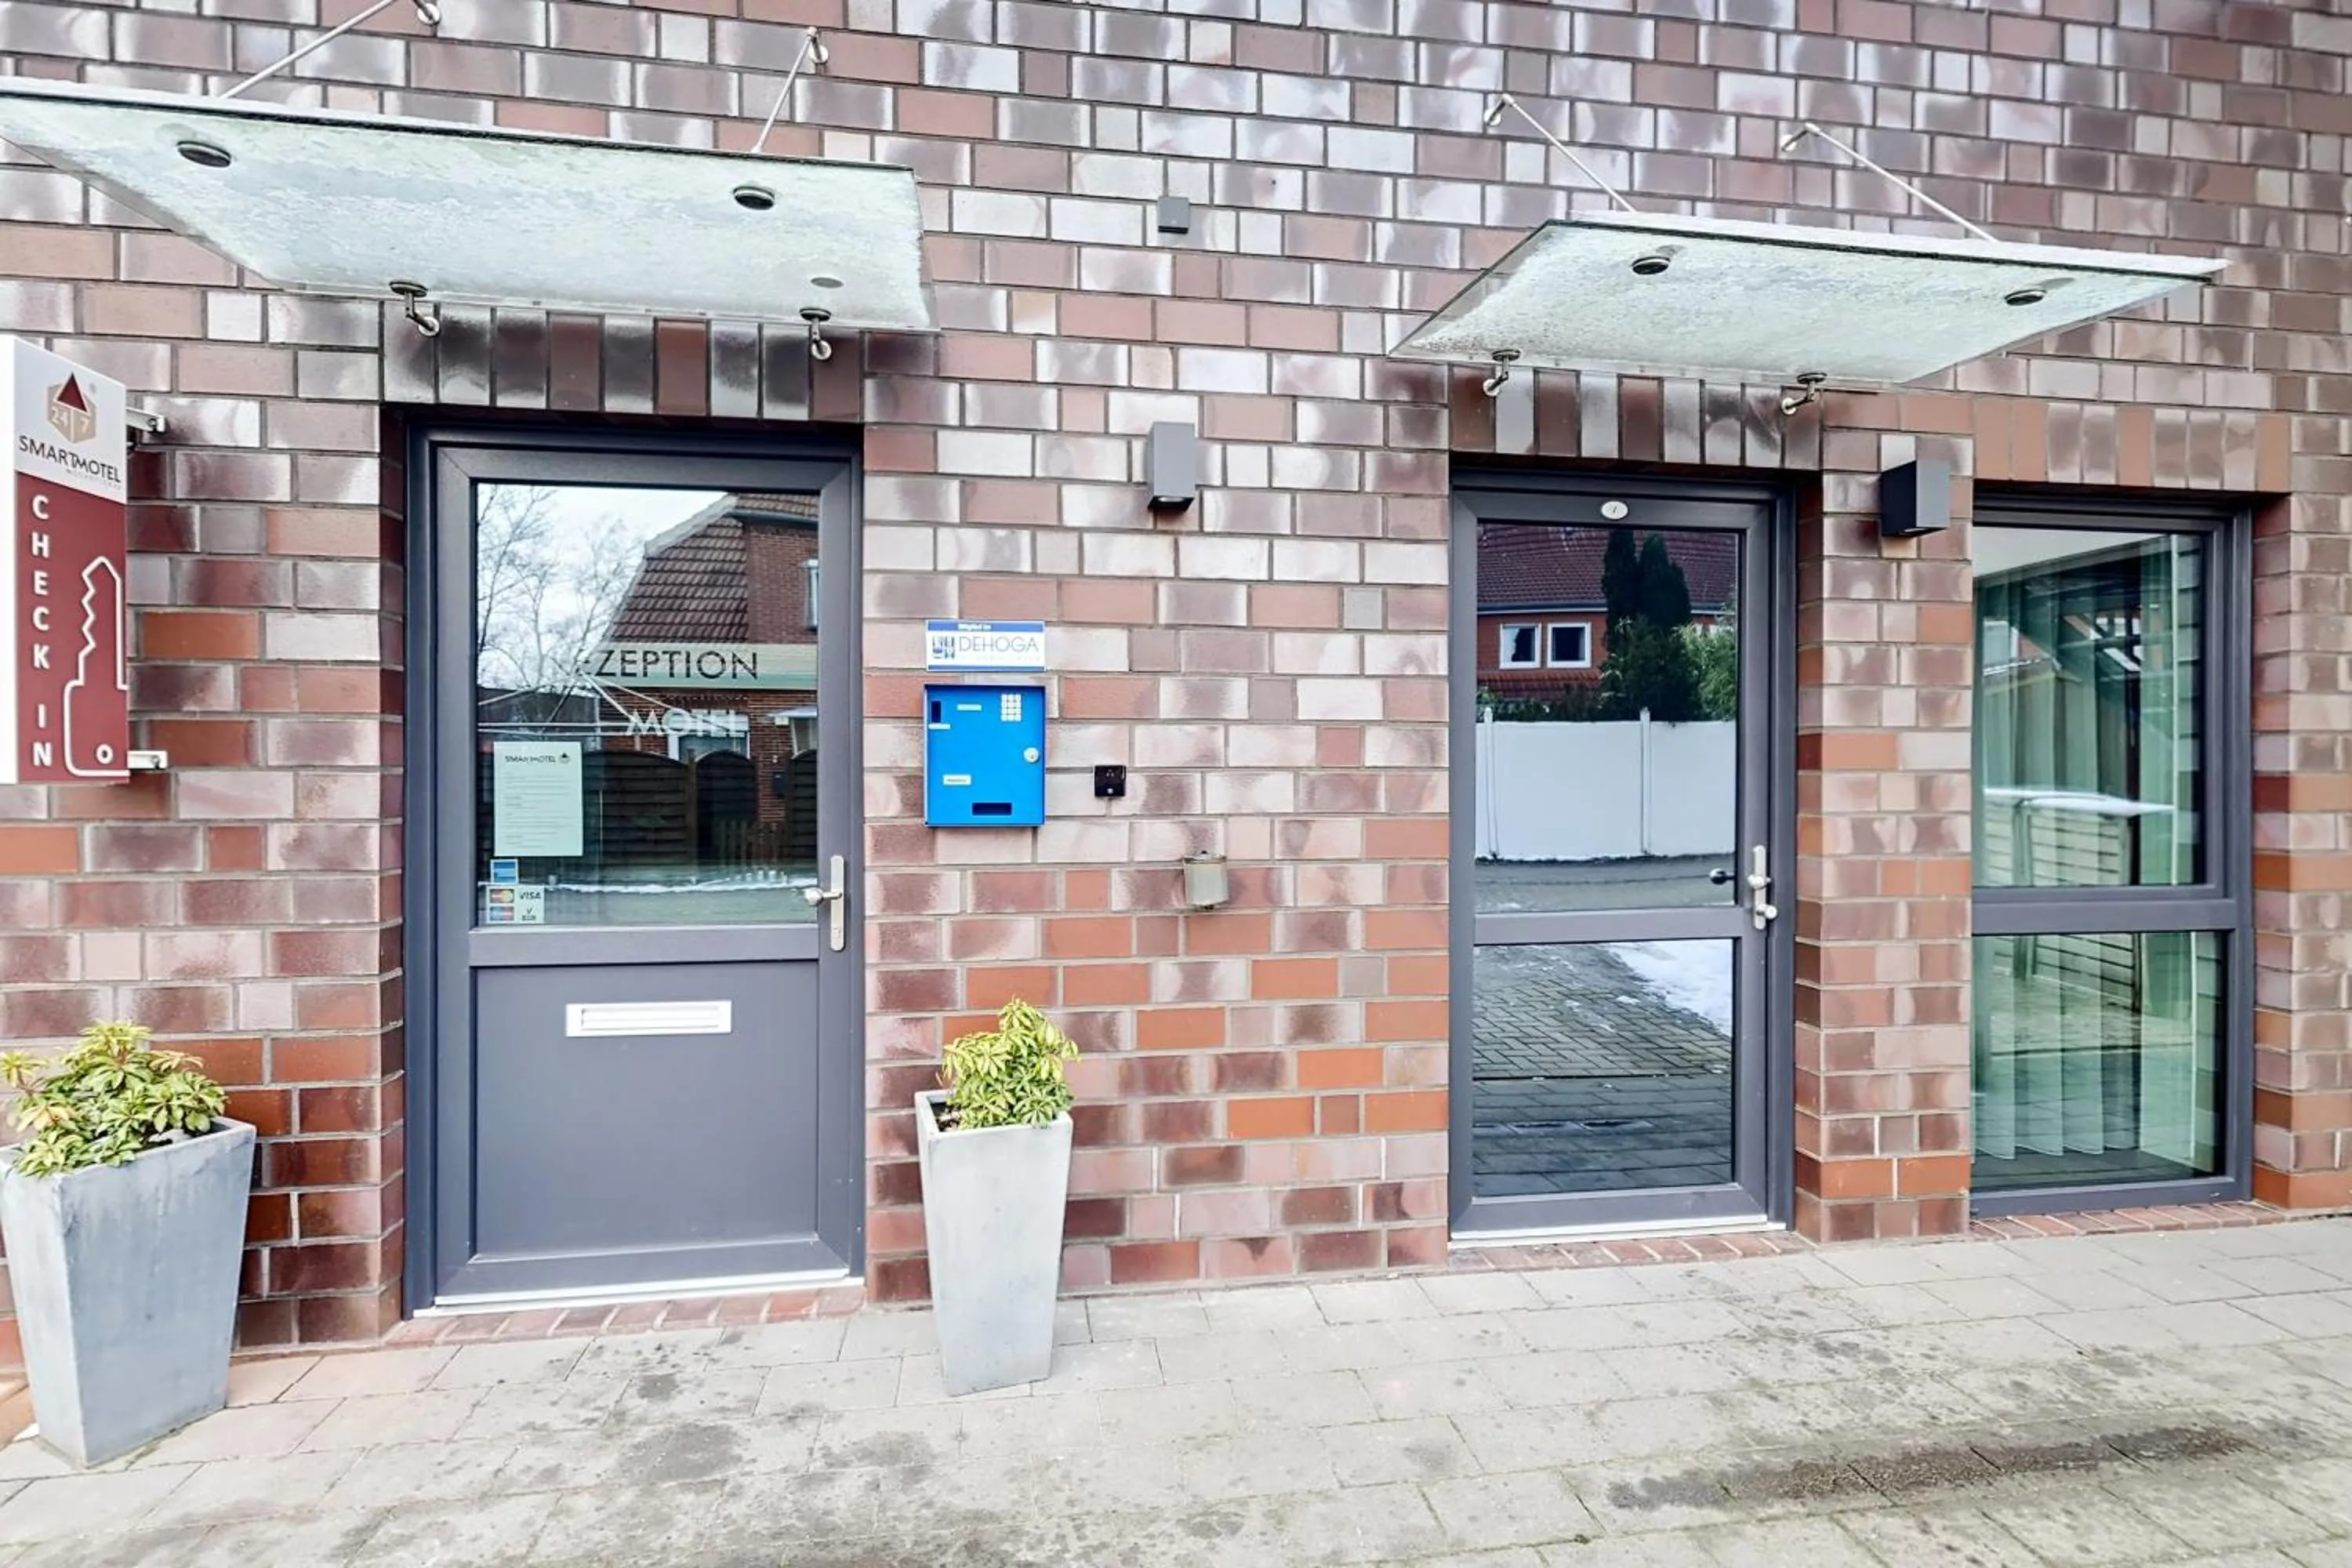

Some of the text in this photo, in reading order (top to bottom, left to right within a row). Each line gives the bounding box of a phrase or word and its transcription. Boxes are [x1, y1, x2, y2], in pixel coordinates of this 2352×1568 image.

[31, 495, 52, 767] CHECK IN
[959, 636, 1039, 652] DEHOGA
[626, 708, 745, 738] MOTEL
[520, 891, 541, 900] VISA
